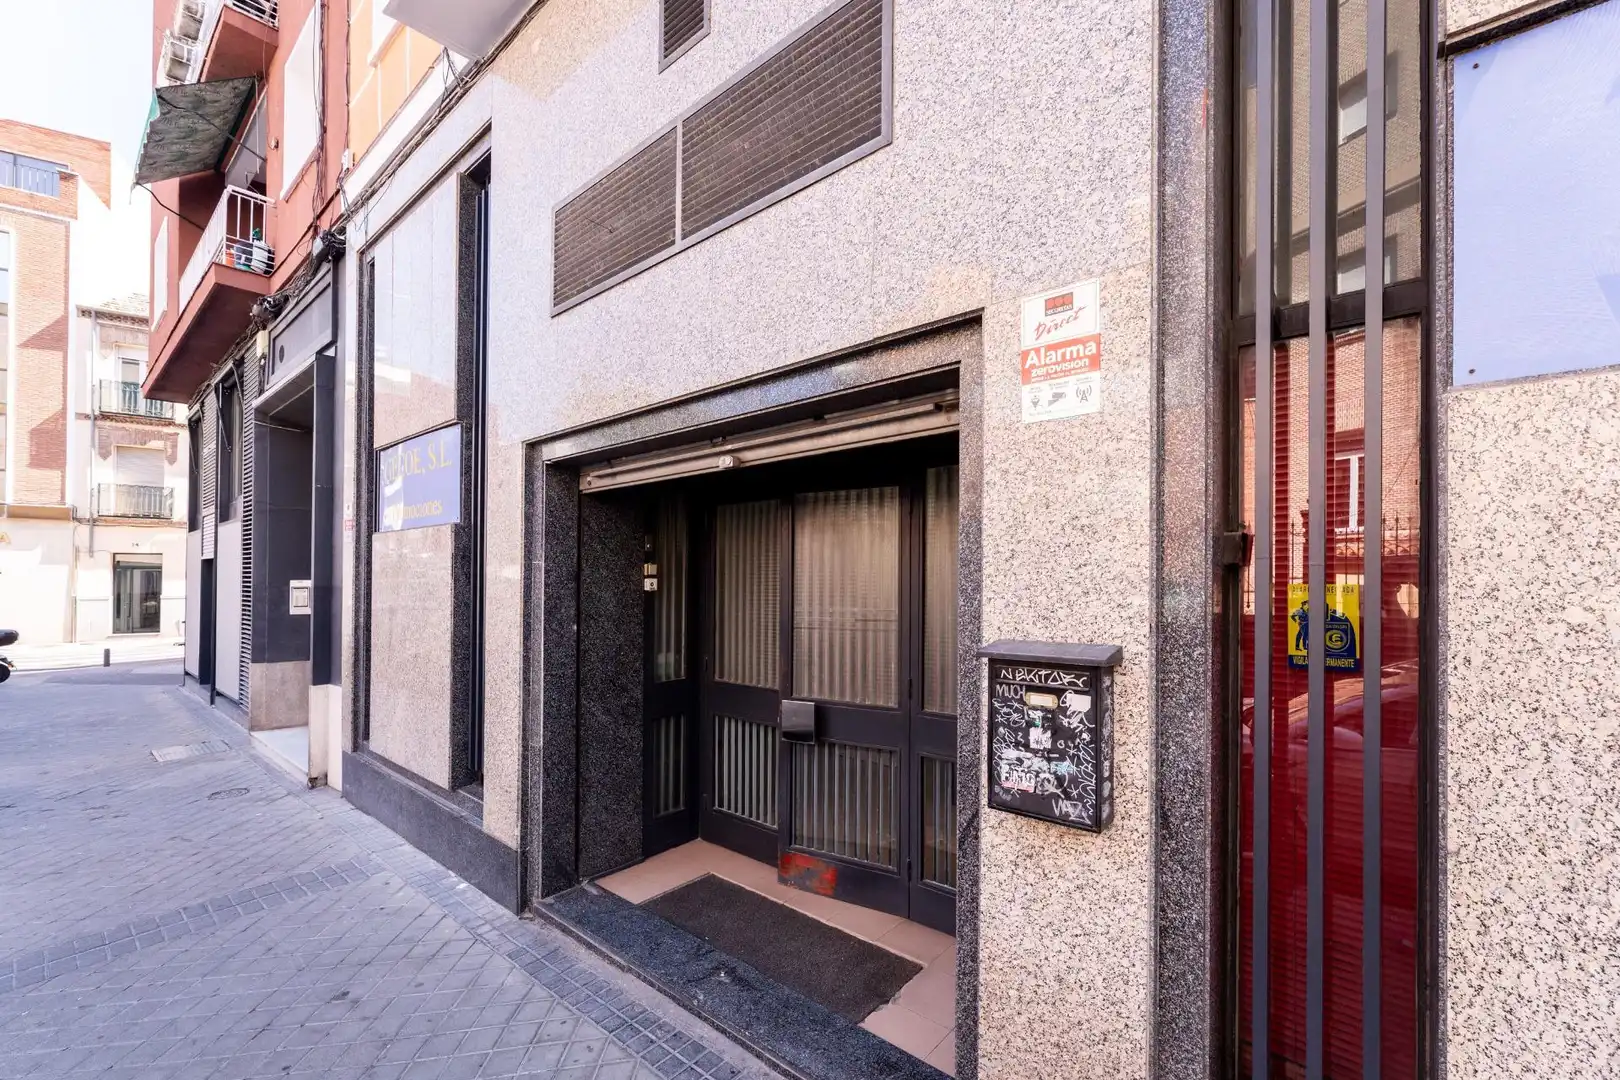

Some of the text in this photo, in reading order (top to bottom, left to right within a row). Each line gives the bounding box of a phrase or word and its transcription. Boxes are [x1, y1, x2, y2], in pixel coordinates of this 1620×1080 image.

[1034, 305, 1088, 341] Direct
[1024, 340, 1097, 369] Alarma
[1031, 357, 1089, 377] zerovision
[1325, 658, 1355, 668] ERMANENTE
